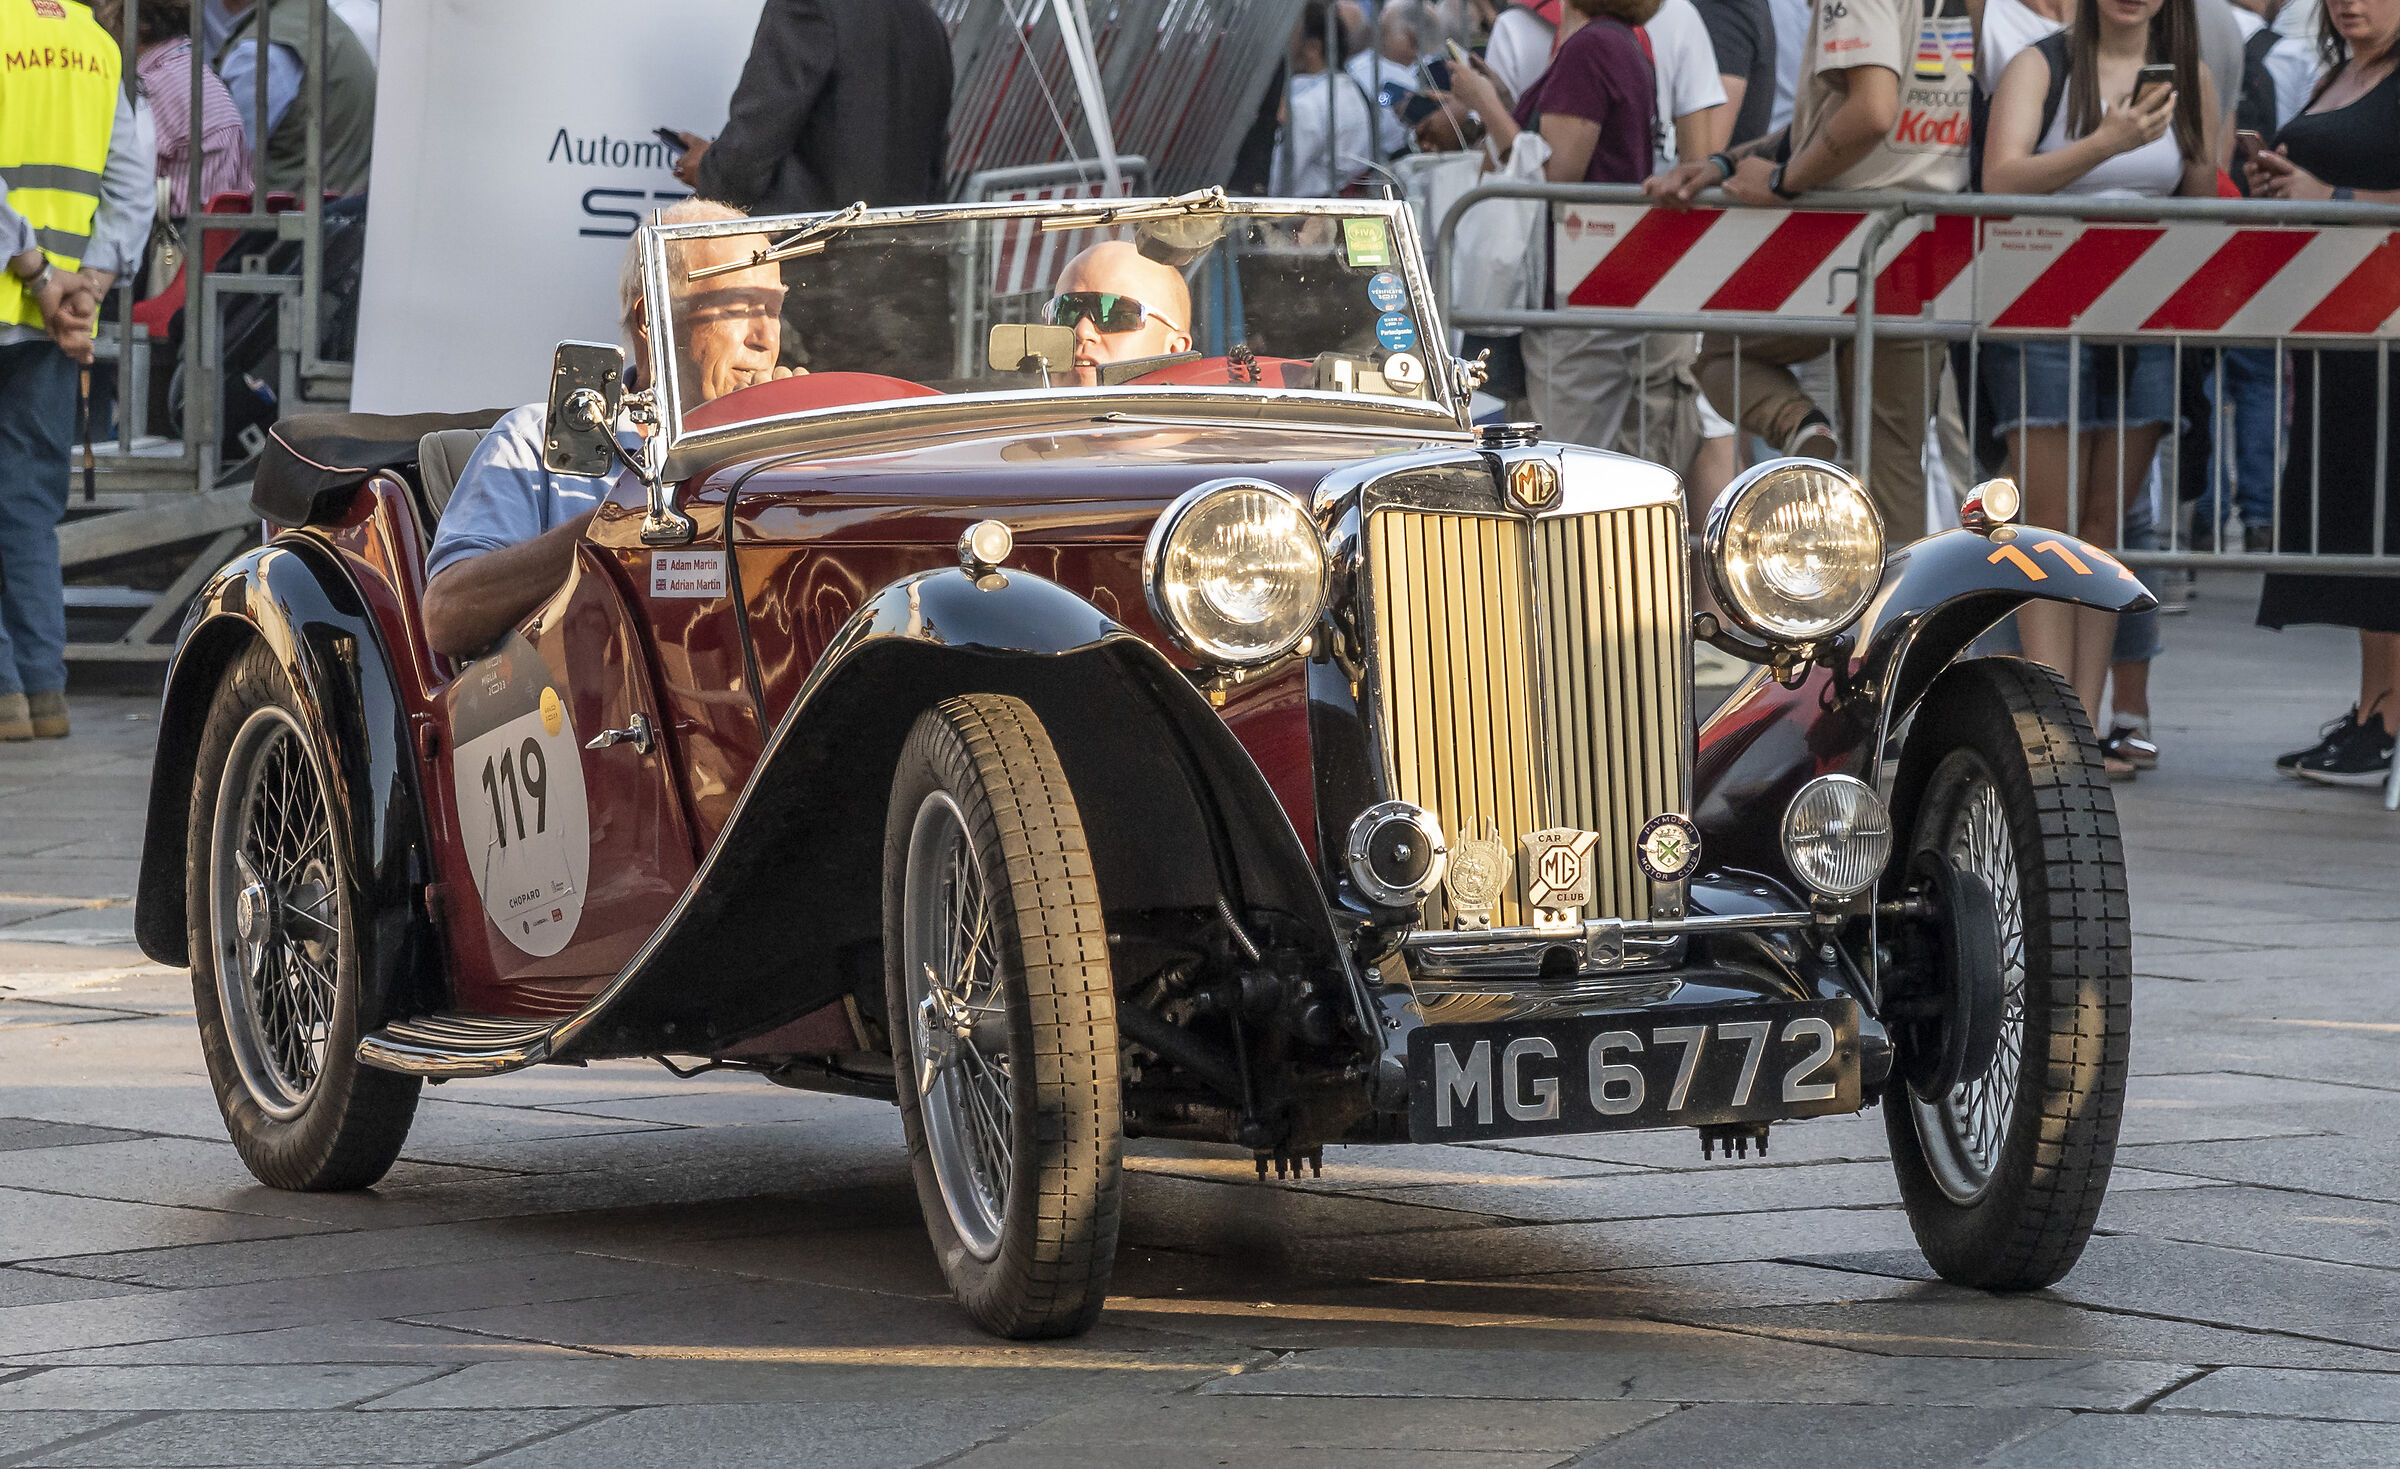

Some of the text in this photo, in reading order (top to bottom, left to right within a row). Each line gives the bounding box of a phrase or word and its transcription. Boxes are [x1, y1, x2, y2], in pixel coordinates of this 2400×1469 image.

[1400, 361, 1410, 377] 9
[1518, 464, 1554, 501] MG
[671, 558, 718, 571] Adam Martin
[670, 578, 721, 591] Adrian Martin
[482, 737, 547, 848] 119
[1644, 816, 1695, 835] PLYMOUTH
[1538, 834, 1561, 842] CAR
[1545, 851, 1576, 885] MG
[1641, 856, 1697, 880] MOTOR CLUB
[509, 888, 541, 909] CHOPARD
[1556, 893, 1584, 901] CLUB
[1434, 1017, 1837, 1128] MG 6772
